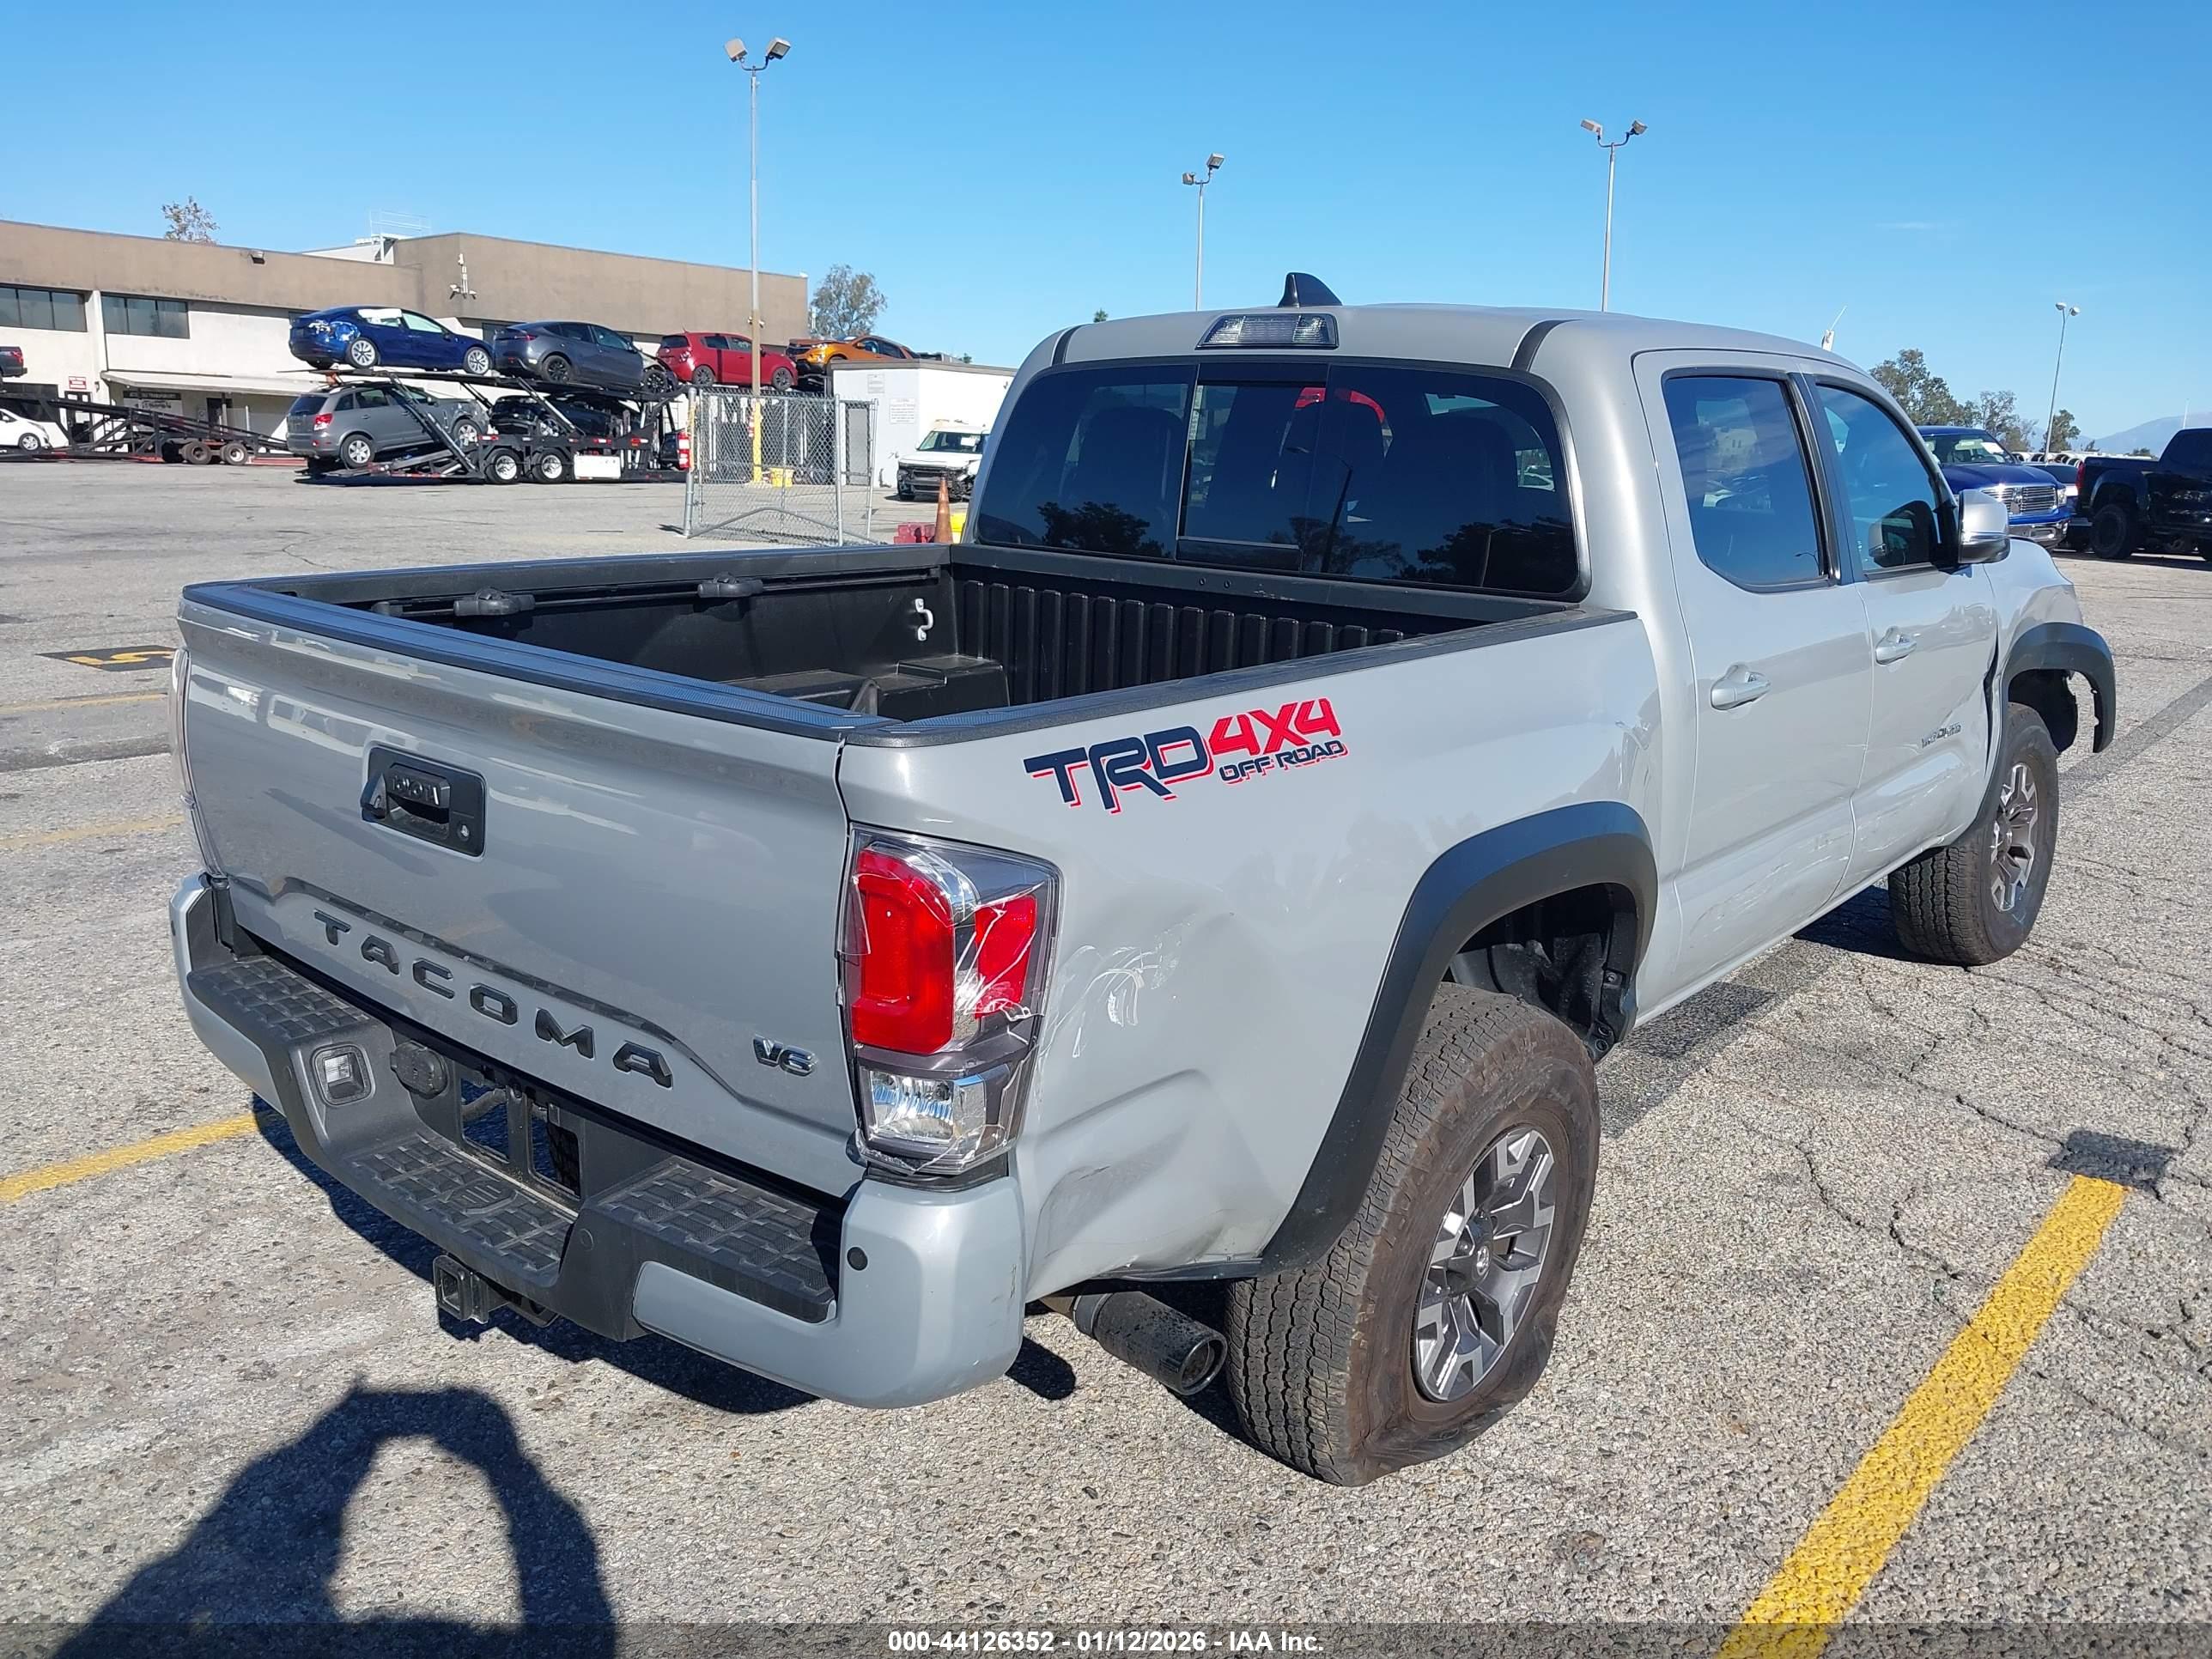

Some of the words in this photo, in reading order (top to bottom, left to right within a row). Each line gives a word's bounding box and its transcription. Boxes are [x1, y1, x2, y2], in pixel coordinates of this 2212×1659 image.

[1023, 726, 1214, 814] TRD
[1208, 697, 1341, 756] 4X4
[1218, 756, 1276, 785] OFF
[1274, 739, 1349, 772] ROAD
[313, 908, 674, 1089] TACOMA
[753, 1033, 817, 1077] V6
